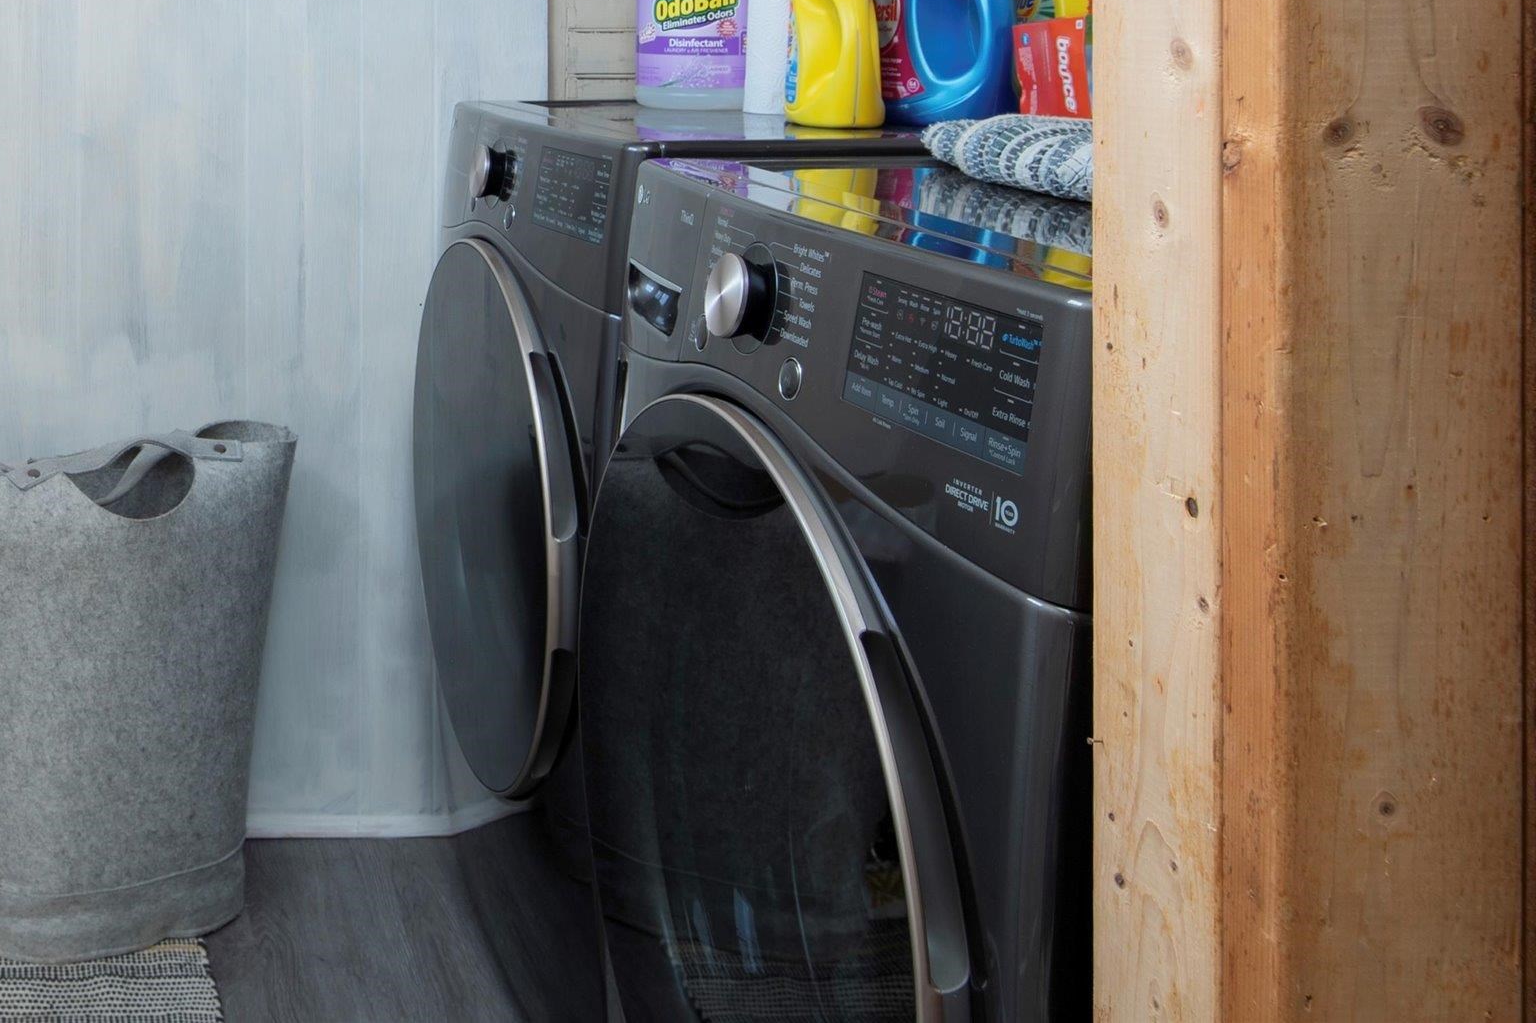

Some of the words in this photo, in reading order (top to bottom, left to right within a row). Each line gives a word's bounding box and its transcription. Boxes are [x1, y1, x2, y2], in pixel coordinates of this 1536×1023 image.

[662, 15, 707, 31] Eliminates
[707, 8, 734, 22] Odors
[876, 0, 898, 22] ersil
[668, 38, 724, 48] Disinfectant
[1056, 36, 1077, 114] bounce
[793, 243, 808, 258] Bright
[799, 262, 822, 278] Delicates
[798, 298, 815, 313] Towels
[999, 369, 1013, 383] Cold
[1014, 373, 1031, 389] Wash
[908, 404, 919, 416] Spin
[992, 406, 1008, 422] Extra
[1009, 413, 1025, 428] Rinse
[935, 417, 946, 429] Soil
[960, 427, 978, 443] Signal
[953, 477, 982, 496] INVERTER
[945, 483, 968, 502] DIRECT
[968, 494, 989, 512] DRIVE
[995, 496, 1019, 527] 10
